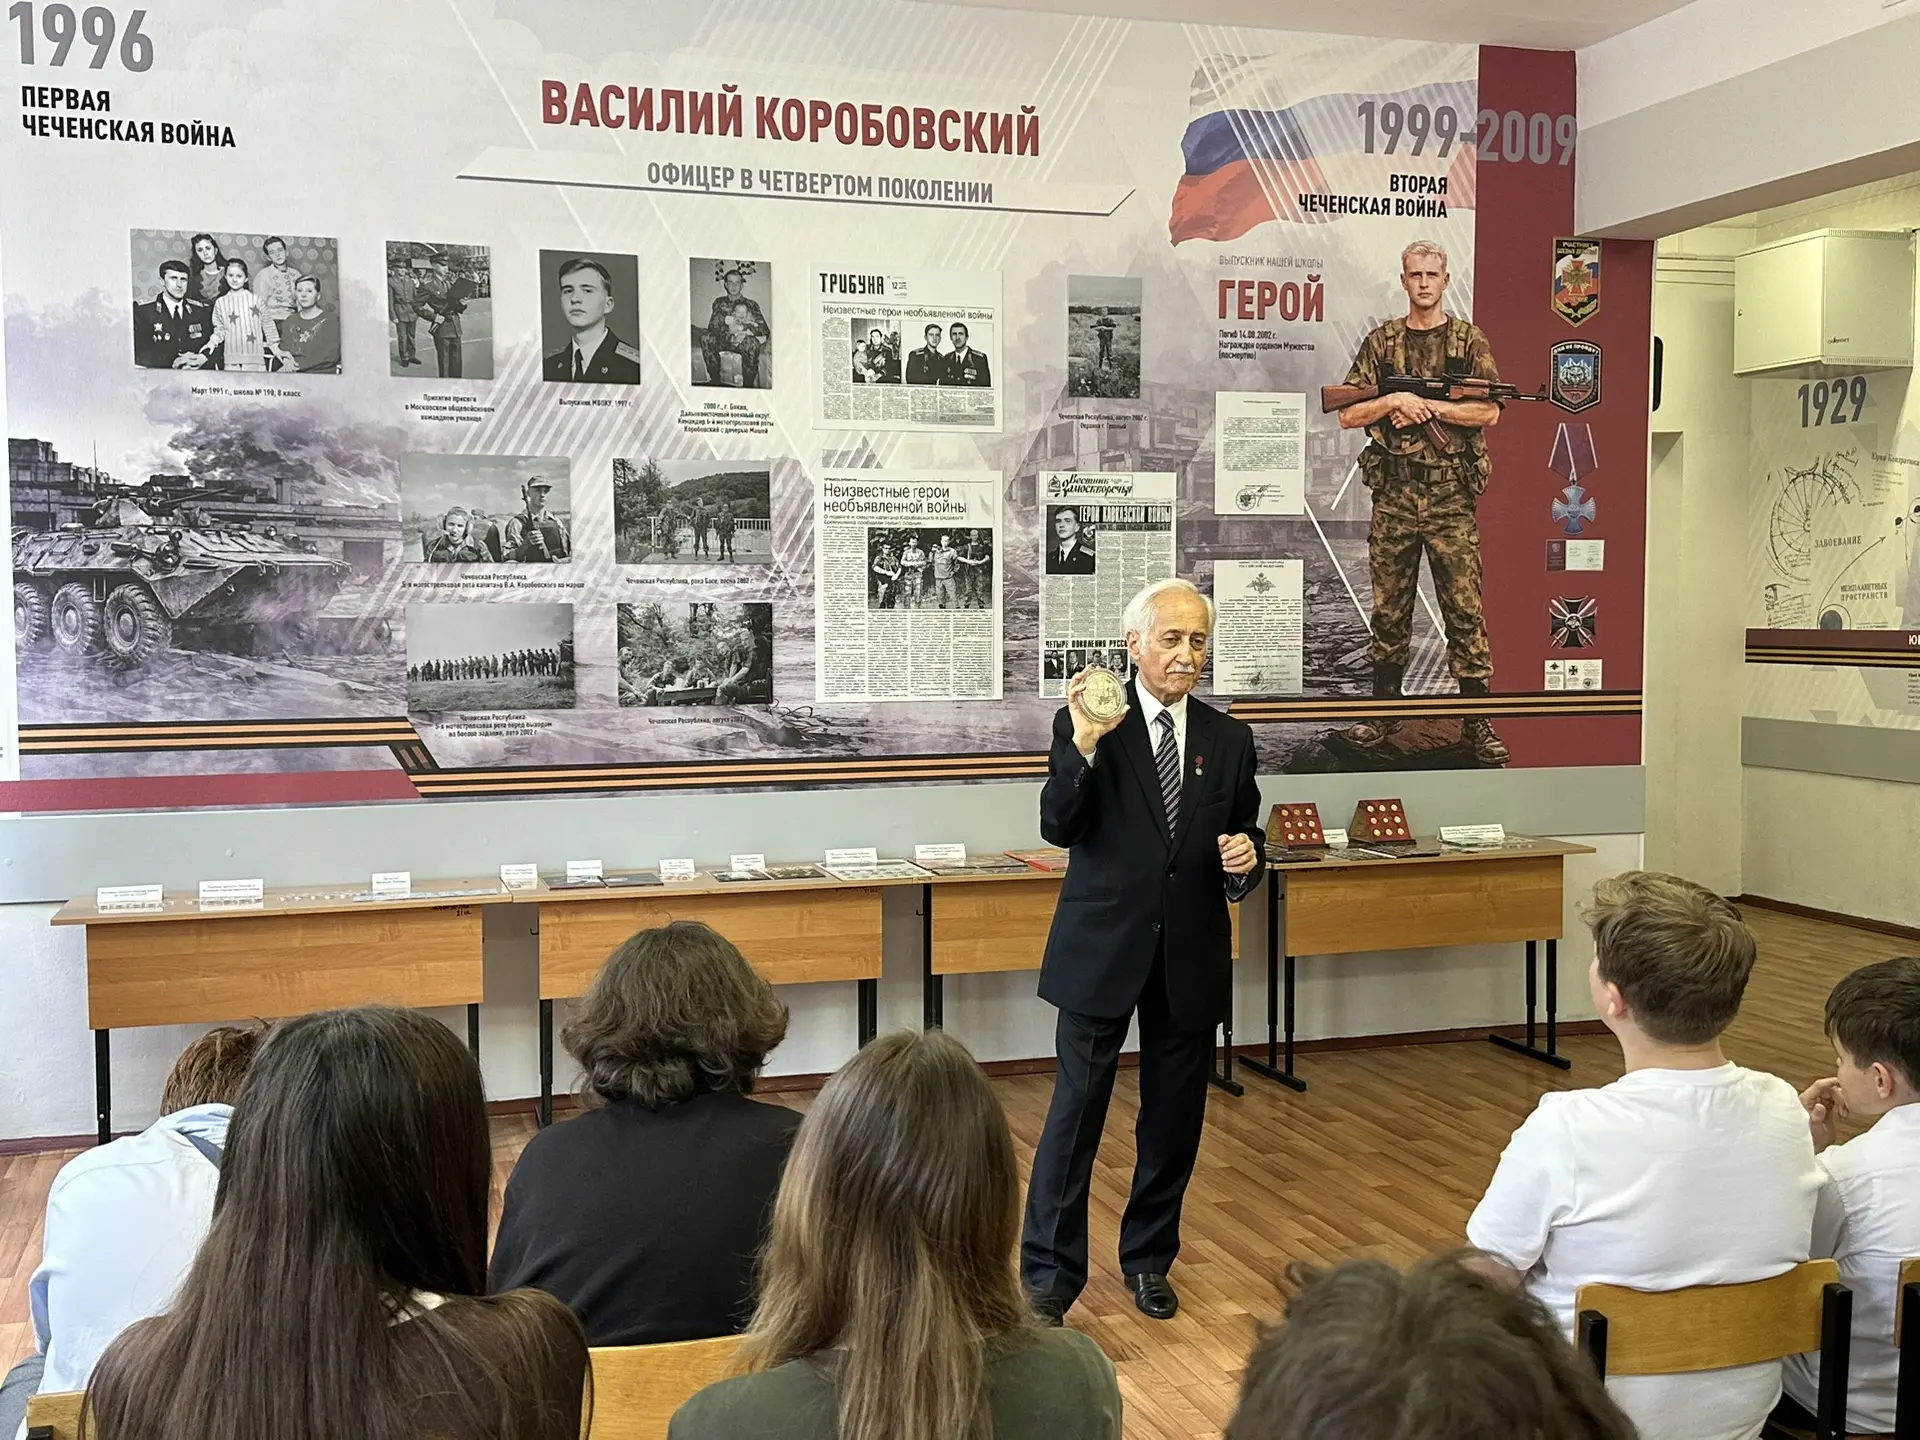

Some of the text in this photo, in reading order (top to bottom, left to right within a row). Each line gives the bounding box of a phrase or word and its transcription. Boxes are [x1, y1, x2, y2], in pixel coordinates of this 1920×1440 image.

[9, 1, 154, 73] 1996
[22, 85, 111, 112] ПЕРВАЯ
[542, 79, 1039, 157] ВАСИЛИЙ КОРОБОВСКИЙ
[22, 114, 236, 148] ЧЕЧЕНСКАЯ ВОЙНА
[1357, 100, 1578, 166] 1999-2009
[647, 162, 993, 204] ОФИЦЕР В ЧЕТВЕРТОМ ПОКОЛЕНИИ
[1390, 174, 1448, 195] ВТОРАЯ
[1299, 193, 1448, 218] ЧЕЧЕНСКАЯ ВОЙНА
[1219, 255, 1324, 268] ВЫПУСКНИК НАШЕЙ ШКОЛЫ
[819, 272, 884, 295] ТРИБУНА
[1218, 274, 1324, 322] ГЕРОЙ
[823, 304, 993, 320] Неизвестные герои необъявленной войны
[1219, 329, 1238, 338] Погиб
[1218, 350, 1257, 361] (посмертно)
[1255, 342, 1282, 350] орденом
[1283, 342, 1315, 351] Мужества
[191, 387, 208, 395] Март
[209, 387, 224, 395] 1991
[1797, 375, 1867, 428] 1929
[1062, 477, 1133, 498] Замоскворечья
[1067, 473, 1110, 485] Вестник
[823, 483, 950, 501] Неизвестные герои
[823, 498, 967, 514] необъявленной войны
[1814, 535, 1862, 548] ЗАВОЕВАНИЕ
[1840, 591, 1888, 602] ПРОСТРАНСТВ
[1045, 640, 1069, 648] ЧЕТЫРЕ
